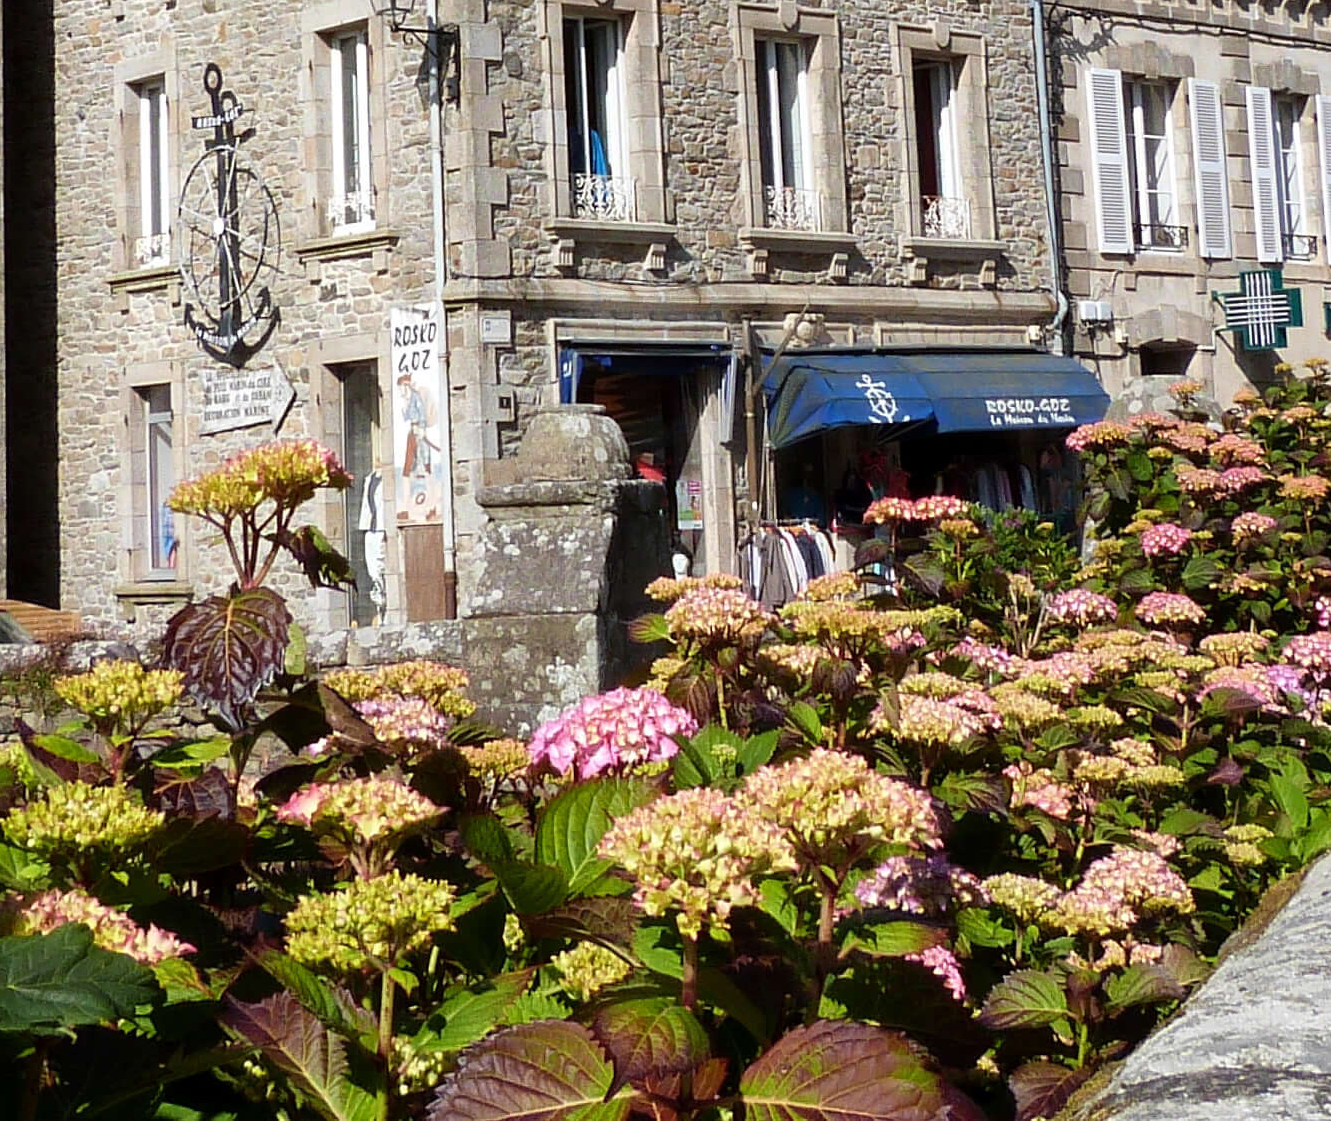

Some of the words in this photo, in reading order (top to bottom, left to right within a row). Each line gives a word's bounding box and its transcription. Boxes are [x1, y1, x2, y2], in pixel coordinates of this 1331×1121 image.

[393, 322, 437, 348] ROSKO
[398, 349, 430, 373] GOZ
[984, 398, 1071, 414] ROSKO-GOZ
[990, 414, 1003, 426] La
